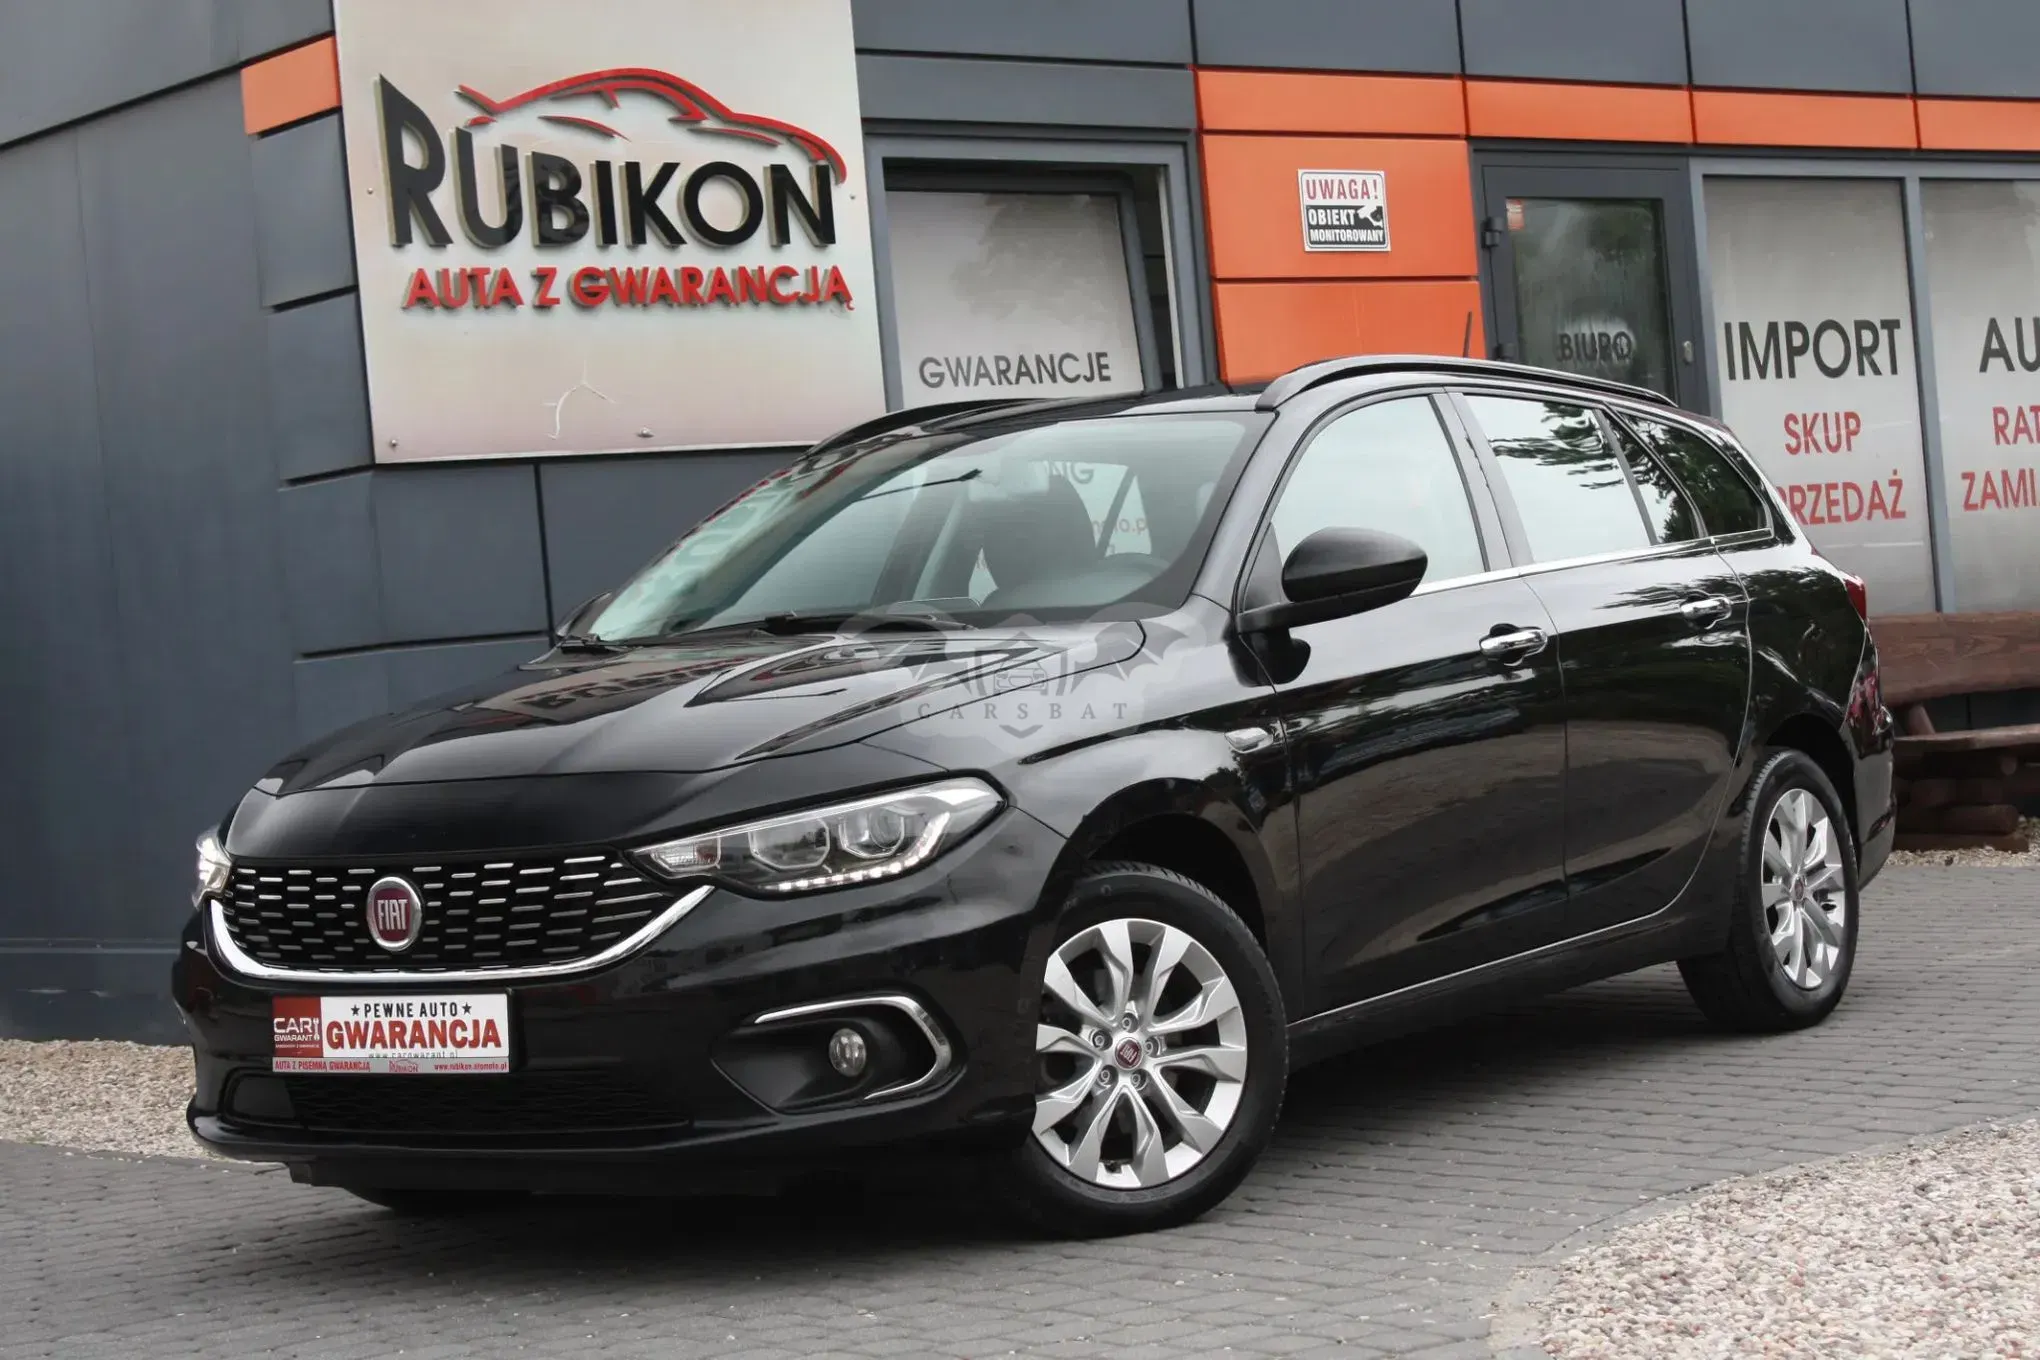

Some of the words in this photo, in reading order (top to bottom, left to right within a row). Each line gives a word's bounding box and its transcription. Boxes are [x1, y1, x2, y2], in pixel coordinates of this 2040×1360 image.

[376, 74, 837, 248] RUBIKON
[1305, 178, 1379, 200] UWAGA!
[1307, 208, 1357, 226] OBIEKT
[1309, 228, 1385, 243] MONITOROWANY
[403, 266, 525, 308] AUTA
[533, 266, 561, 306] Z
[569, 264, 855, 311] GWARANCJĄ
[1557, 331, 1632, 361] BIURO
[1723, 319, 1901, 381] IMPORT
[918, 351, 1112, 388] GWARANCJE
[1783, 411, 1862, 456] SKUP
[1775, 469, 1907, 526] RZEDAŻ
[376, 898, 409, 931] FIAT
[364, 1003, 414, 1018] PEWNE
[419, 1001, 458, 1017] AUTO
[273, 1017, 313, 1034] CAR
[273, 1033, 313, 1042] GWARANT
[325, 1019, 502, 1050] GWARANCJA
